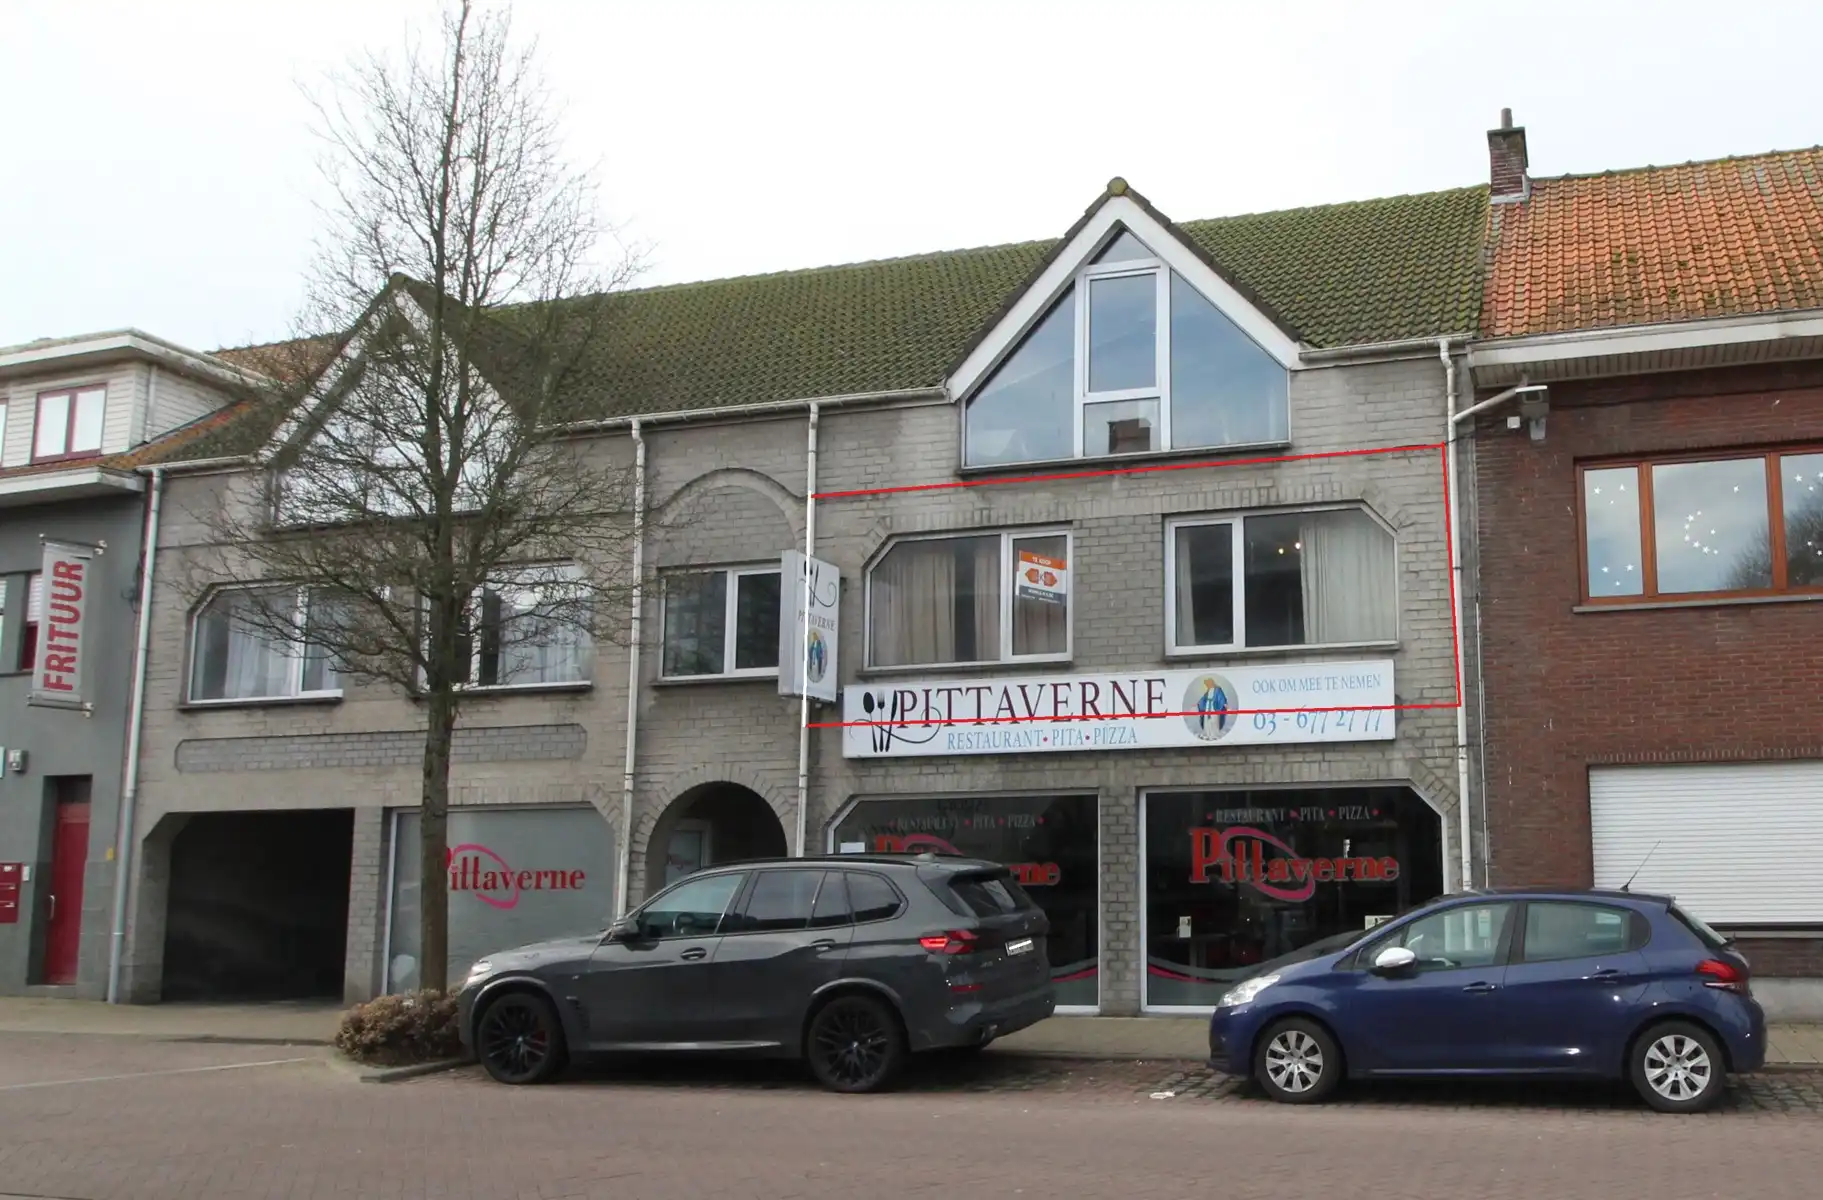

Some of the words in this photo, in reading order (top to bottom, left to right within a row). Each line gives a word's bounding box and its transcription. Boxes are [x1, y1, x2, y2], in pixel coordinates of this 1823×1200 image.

[43, 559, 84, 691] FRITUUR
[1252, 679, 1276, 694] OOK
[1278, 677, 1297, 692] OM
[1299, 676, 1322, 691] MEE
[1325, 676, 1338, 690] TE
[1340, 674, 1381, 690] NEMEN
[897, 678, 1168, 729] PITTAVERNE
[1253, 710, 1277, 735] 03
[1296, 705, 1329, 734] 677
[1335, 708, 1356, 732] 27
[947, 729, 1044, 750] RESTAURANT
[1052, 727, 1084, 747] PITA
[1093, 726, 1138, 745] PIZZA
[973, 813, 996, 830] PITA
[1008, 813, 1036, 829] PIZZA
[1216, 807, 1286, 823] RESTAURANT
[1299, 806, 1325, 822] PITA
[1338, 805, 1371, 821] PIZZA
[446, 847, 586, 891] ittaverne
[1188, 827, 1400, 884] Pittaverne
